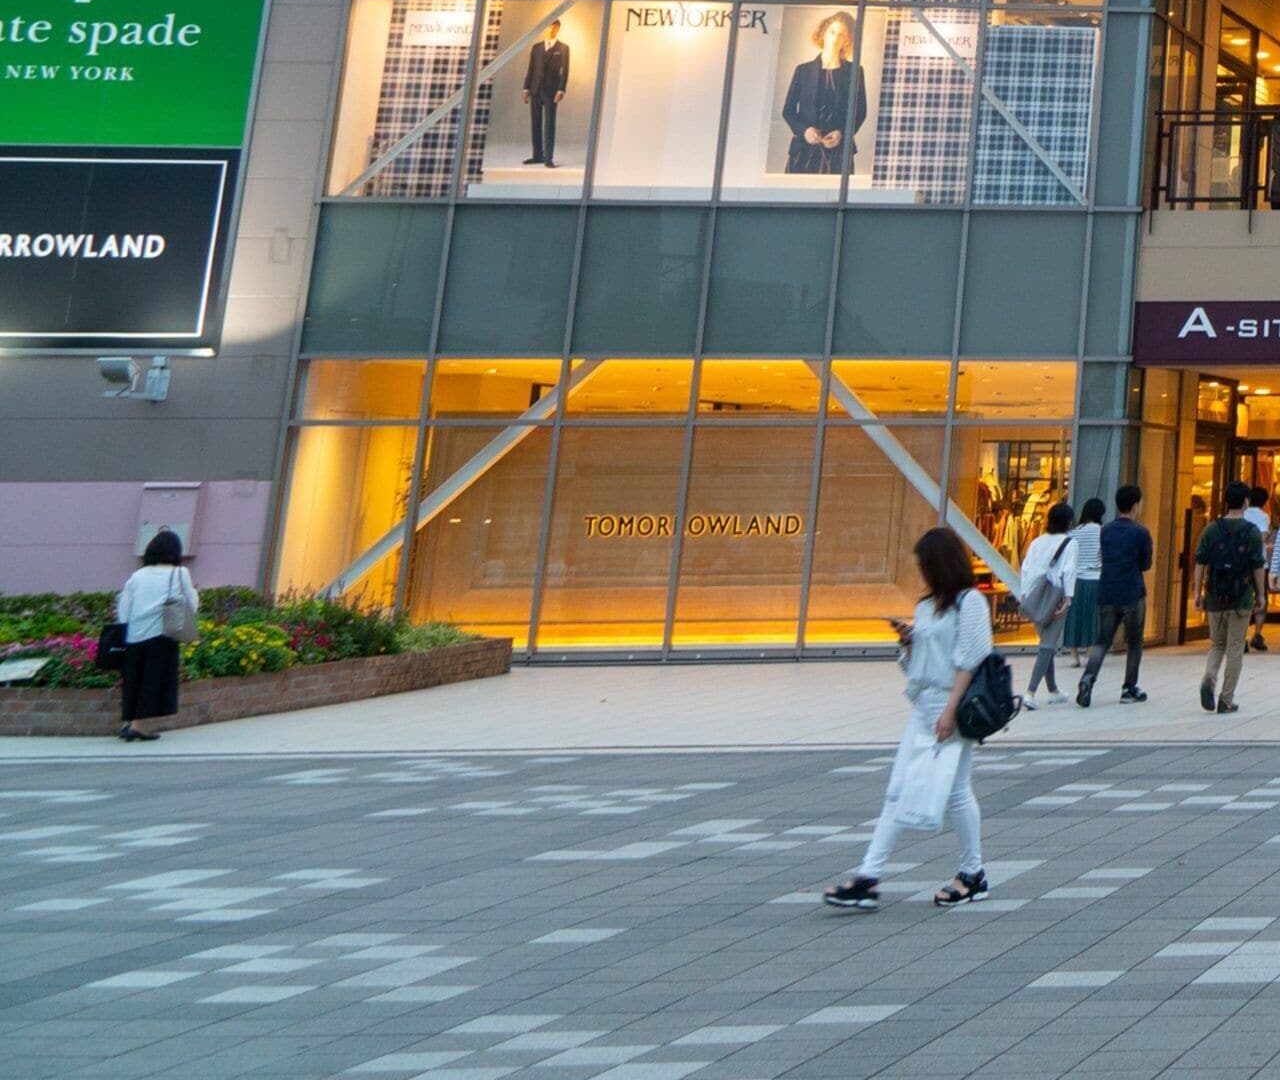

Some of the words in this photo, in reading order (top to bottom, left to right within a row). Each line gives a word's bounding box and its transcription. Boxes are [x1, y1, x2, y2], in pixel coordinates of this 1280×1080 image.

[68, 13, 201, 56] spade
[4, 64, 60, 80] NEW
[70, 66, 134, 81] YORK
[584, 515, 802, 536] TOMOROWLAND
